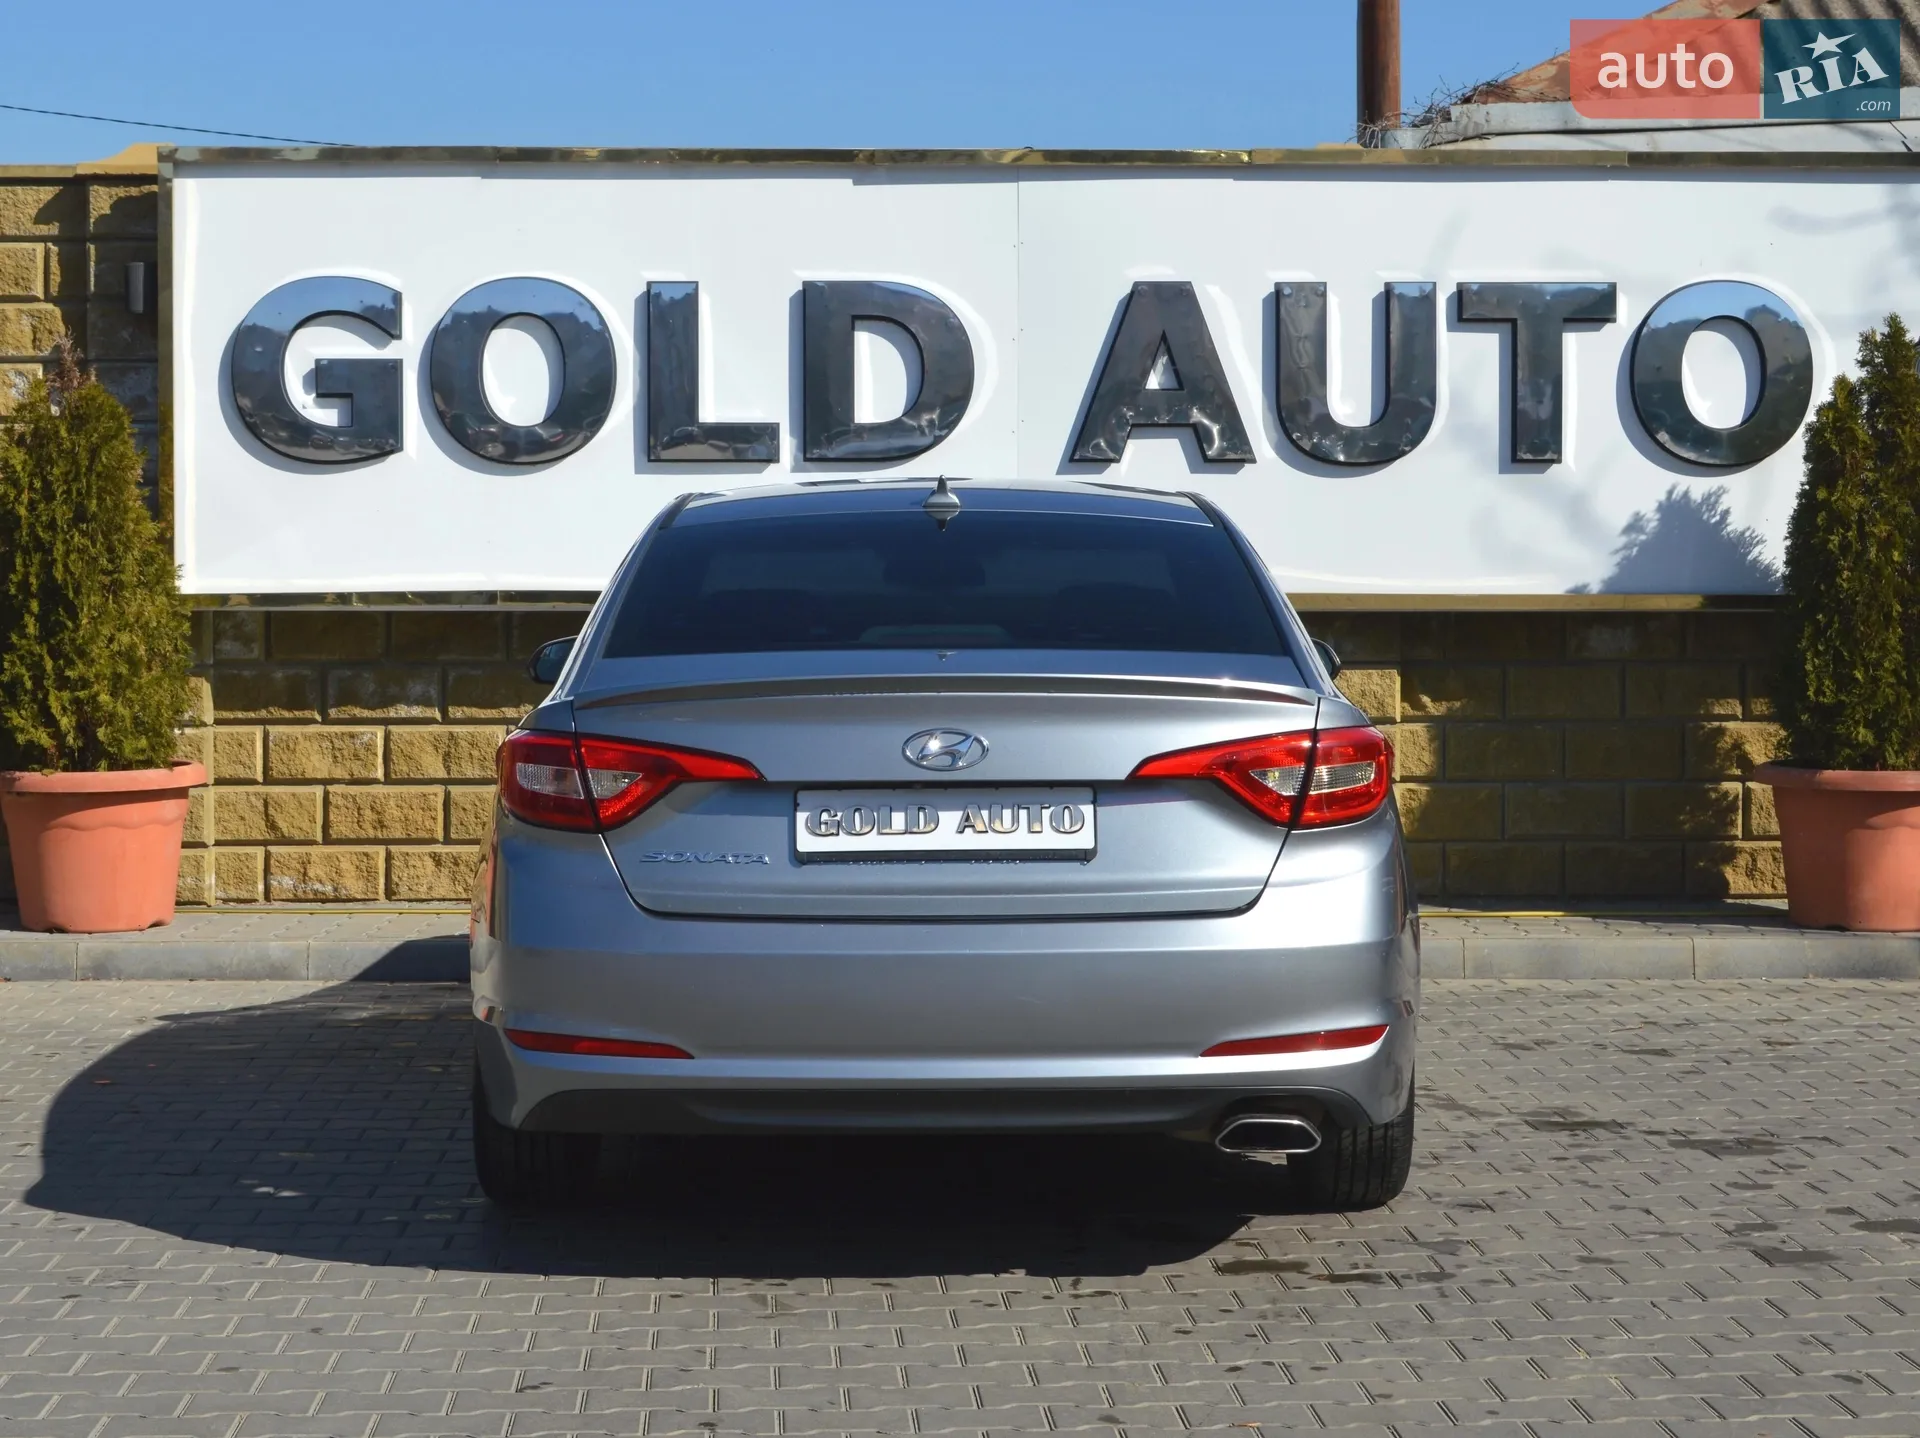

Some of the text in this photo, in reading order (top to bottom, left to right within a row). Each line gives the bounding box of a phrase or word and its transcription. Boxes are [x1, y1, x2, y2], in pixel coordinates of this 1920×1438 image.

[230, 275, 1815, 467] GOLD AUTO
[805, 802, 1085, 837] GOLD AUTO
[640, 850, 770, 865] SONATA
